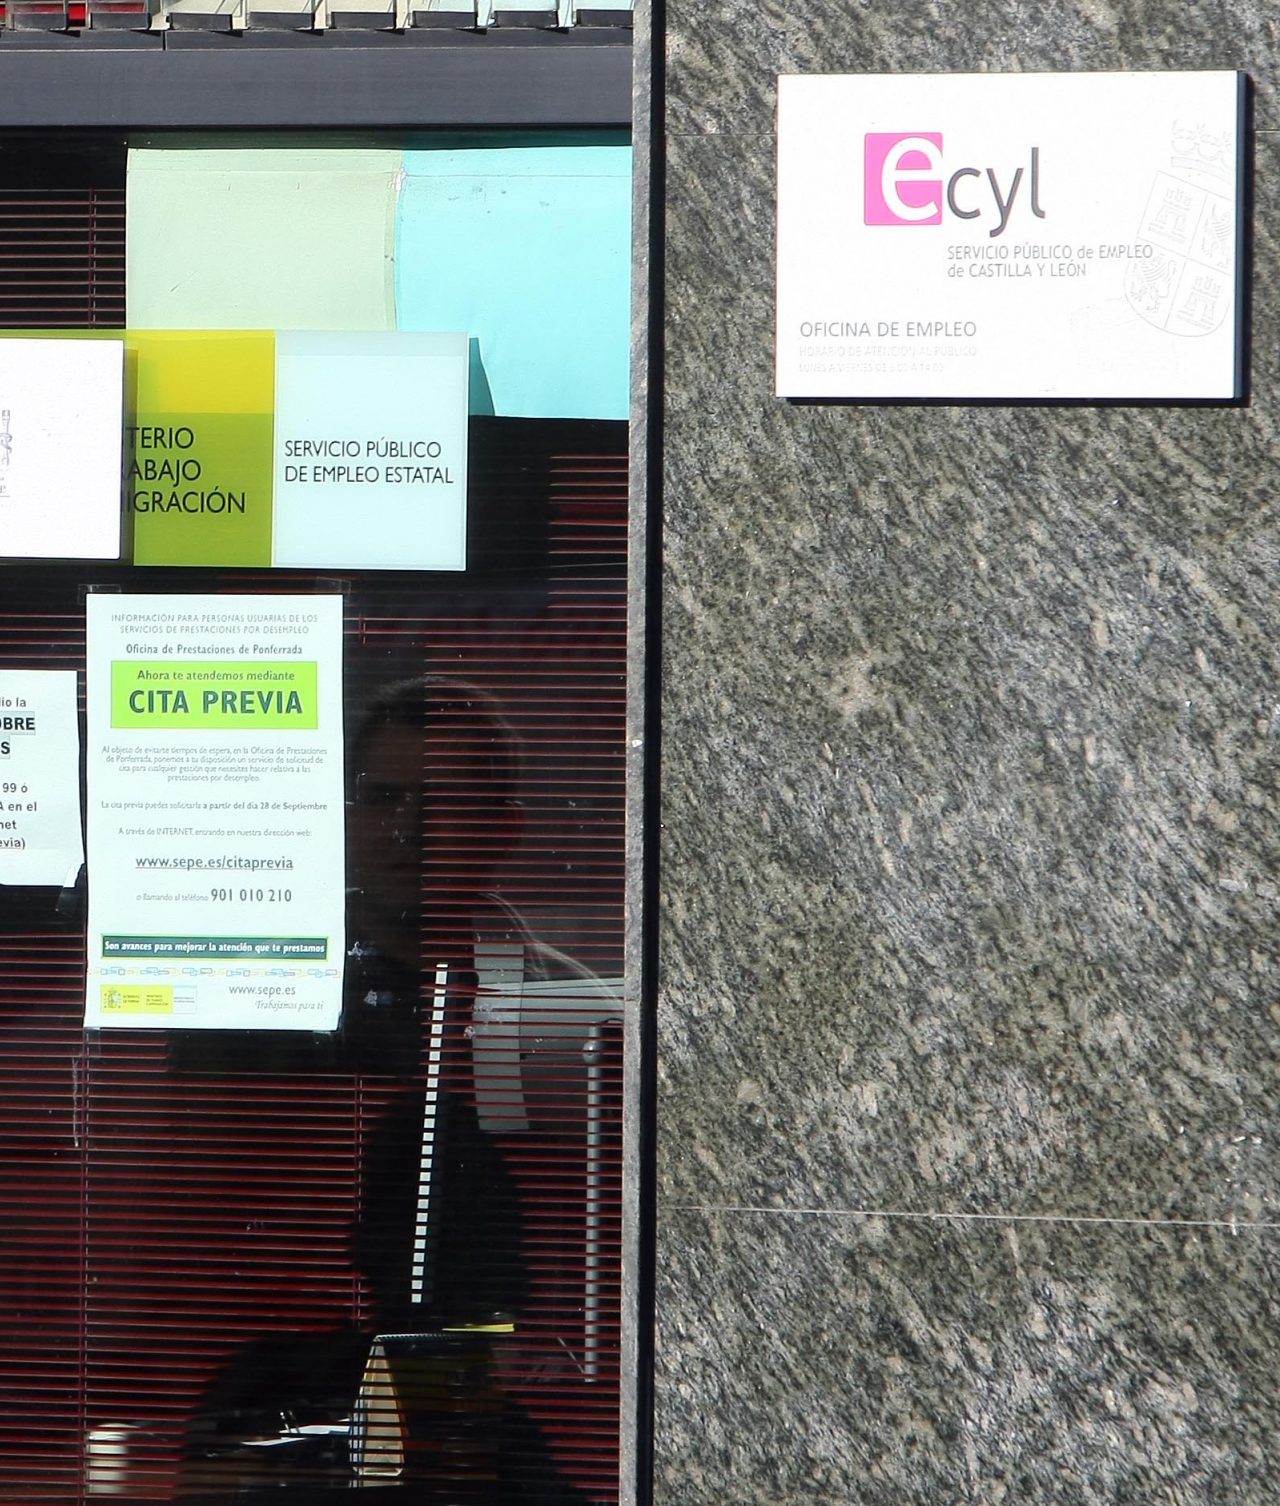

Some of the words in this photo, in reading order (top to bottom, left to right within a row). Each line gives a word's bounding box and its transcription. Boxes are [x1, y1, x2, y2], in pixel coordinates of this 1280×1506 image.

[881, 136, 1046, 238] ecyl
[947, 245, 1009, 260] SERVICIO
[1014, 242, 1074, 261] PÚBLICO
[1077, 245, 1094, 259] de
[1099, 242, 1154, 261] EMPLEO
[947, 263, 965, 278] de
[969, 262, 1032, 278] CASTILLA
[1036, 263, 1045, 277] Y
[1050, 260, 1086, 277] LEÓN
[800, 321, 871, 338] OFICINA
[877, 321, 900, 337] DE
[906, 321, 977, 337] EMPLEO
[125, 427, 194, 449] TERIO
[285, 439, 361, 457] SERVICIO
[366, 437, 441, 458] PÚBLICO
[124, 459, 201, 487] ABAJO
[285, 465, 308, 482] DE
[313, 466, 380, 483] EMPLEO
[385, 466, 454, 484] ESTATAL
[126, 486, 245, 513] IGRACIÓN
[111, 613, 175, 623] INFORMACIÓN
[177, 614, 199, 622] PARA
[201, 614, 245, 623] PERSONAS
[247, 614, 286, 623] USUARIAS
[289, 614, 300, 623] DE
[302, 614, 318, 623] LOS
[120, 625, 163, 634] SERVICIOS
[166, 625, 178, 634] DE
[180, 625, 241, 634] PRESTACIONES
[243, 626, 260, 634] POR
[263, 625, 309, 634] DESEMPLEO
[126, 643, 158, 654] Oficina
[162, 643, 173, 654] de
[177, 644, 235, 654] Prestaciones
[239, 644, 249, 654] de
[253, 644, 302, 655] Ponferrada
[136, 669, 170, 680] Ahora
[173, 672, 183, 680] te
[186, 670, 243, 680] atendemos
[246, 670, 295, 681] mediante
[16, 697, 26, 707] la
[129, 690, 189, 714] CITA
[203, 690, 303, 715] PREVIA
[2, 782, 17, 793] 99
[8, 803, 22, 812] en
[26, 801, 37, 812] el
[123, 801, 144, 810] previa
[145, 801, 168, 811] puedes
[170, 801, 201, 809] solicitarla
[209, 802, 231, 811] partir
[233, 801, 245, 810] del
[283, 802, 327, 812] Septiembre
[135, 855, 294, 872] www.sepe.es/citaprevia
[211, 888, 232, 901] 901
[239, 888, 264, 902] 010
[268, 889, 292, 902] 210
[105, 940, 120, 950] Son
[154, 943, 173, 953] para
[175, 941, 207, 953] mejorar
[209, 942, 217, 951] la
[218, 942, 252, 954] atención
[255, 943, 270, 954] que
[272, 942, 282, 952] te
[283, 944, 325, 955] prestamos
[229, 986, 296, 998] www.sepe.es
